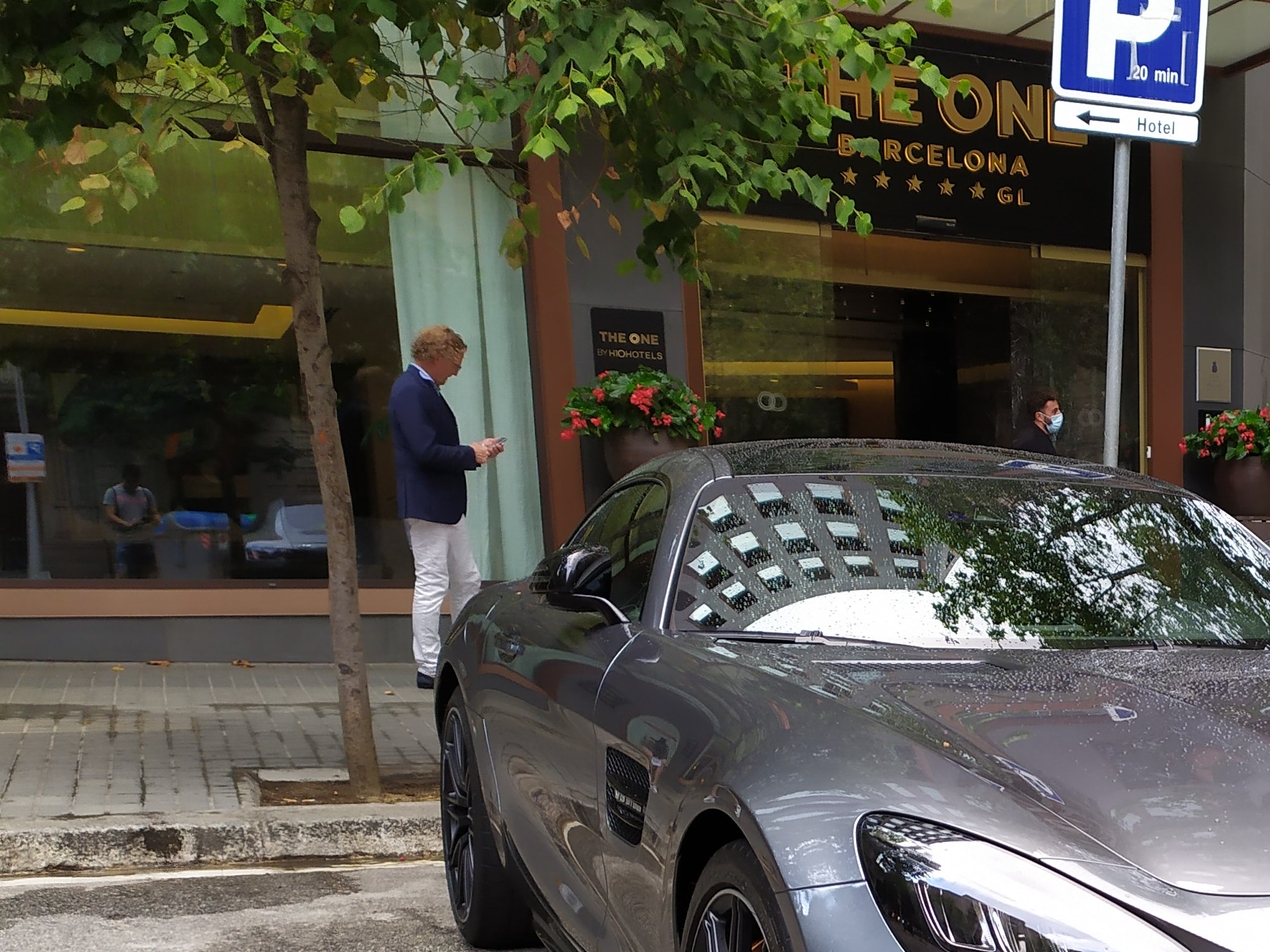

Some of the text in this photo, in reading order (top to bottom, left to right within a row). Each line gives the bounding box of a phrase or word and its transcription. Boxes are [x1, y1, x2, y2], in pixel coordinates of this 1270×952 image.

[1086, 0, 1176, 81] P
[1132, 65, 1179, 85] 20 min
[1137, 117, 1176, 135] Hotel
[838, 133, 1030, 178] BRCELONA
[997, 186, 1031, 206] GL
[599, 331, 659, 345] THE ONE
[598, 348, 607, 356] BY
